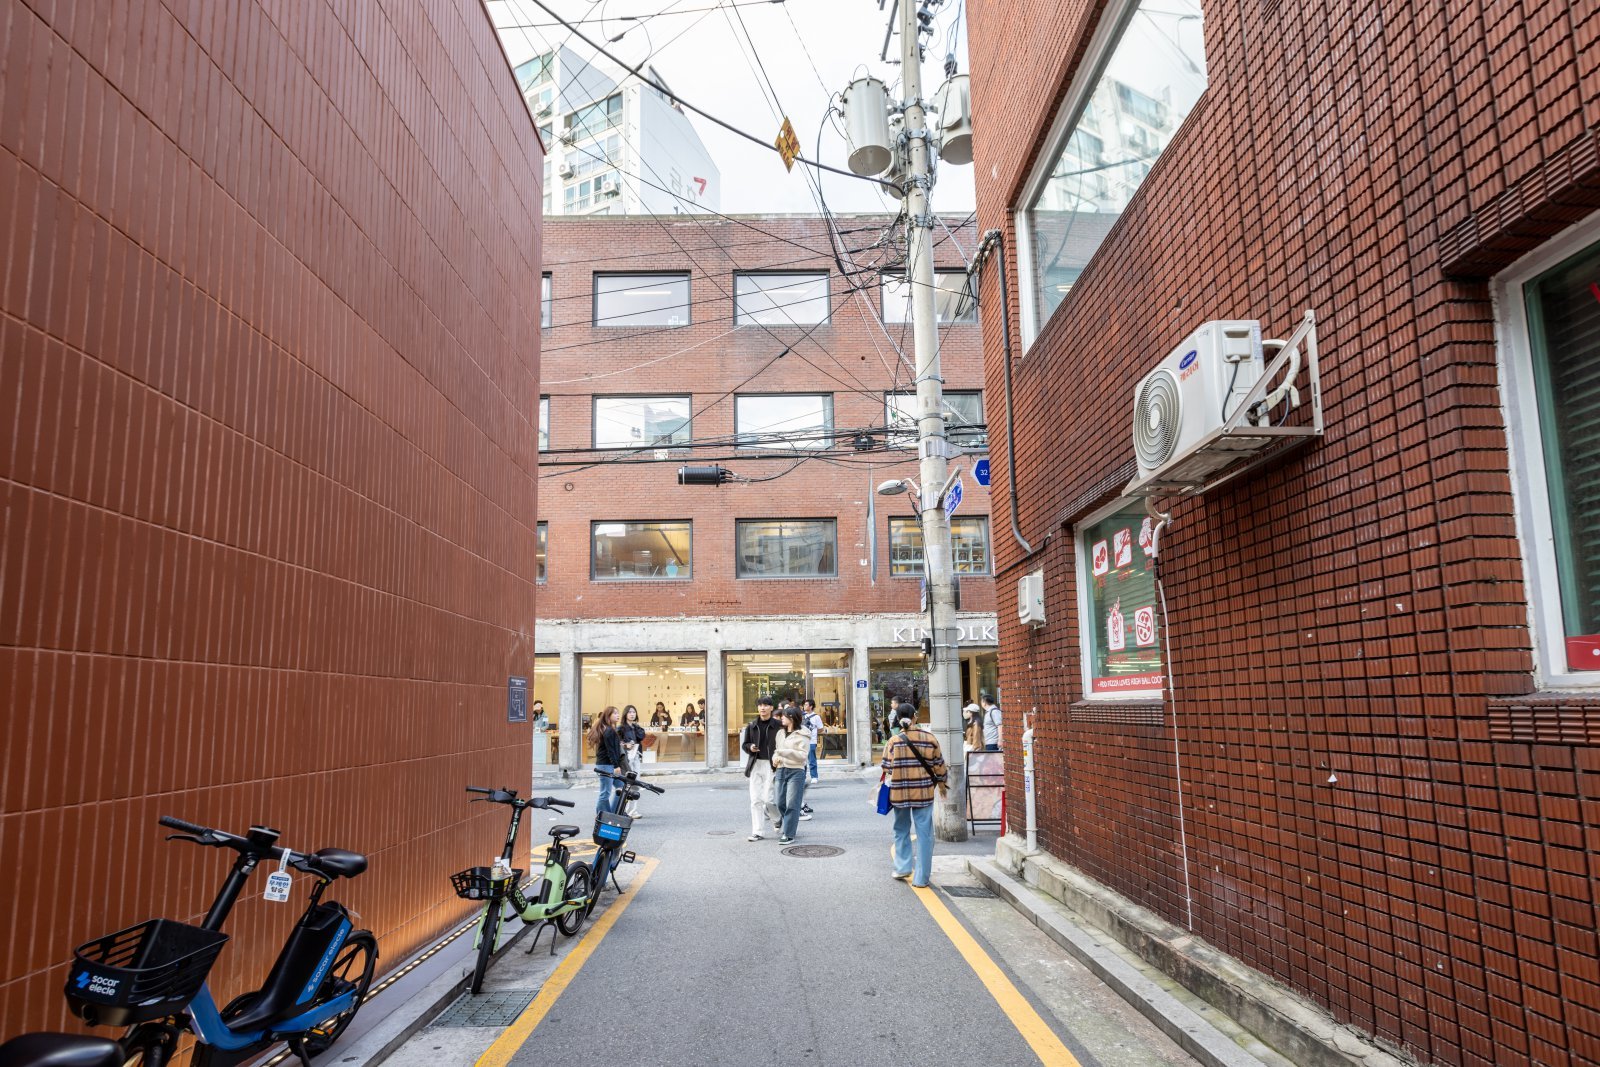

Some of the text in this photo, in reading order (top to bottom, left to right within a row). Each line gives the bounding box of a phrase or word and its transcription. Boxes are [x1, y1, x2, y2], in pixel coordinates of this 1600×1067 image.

[893, 625, 997, 643] KINOLK
[313, 928, 345, 983] socar elecle
[92, 975, 120, 987] socar
[89, 983, 116, 996] elecle
